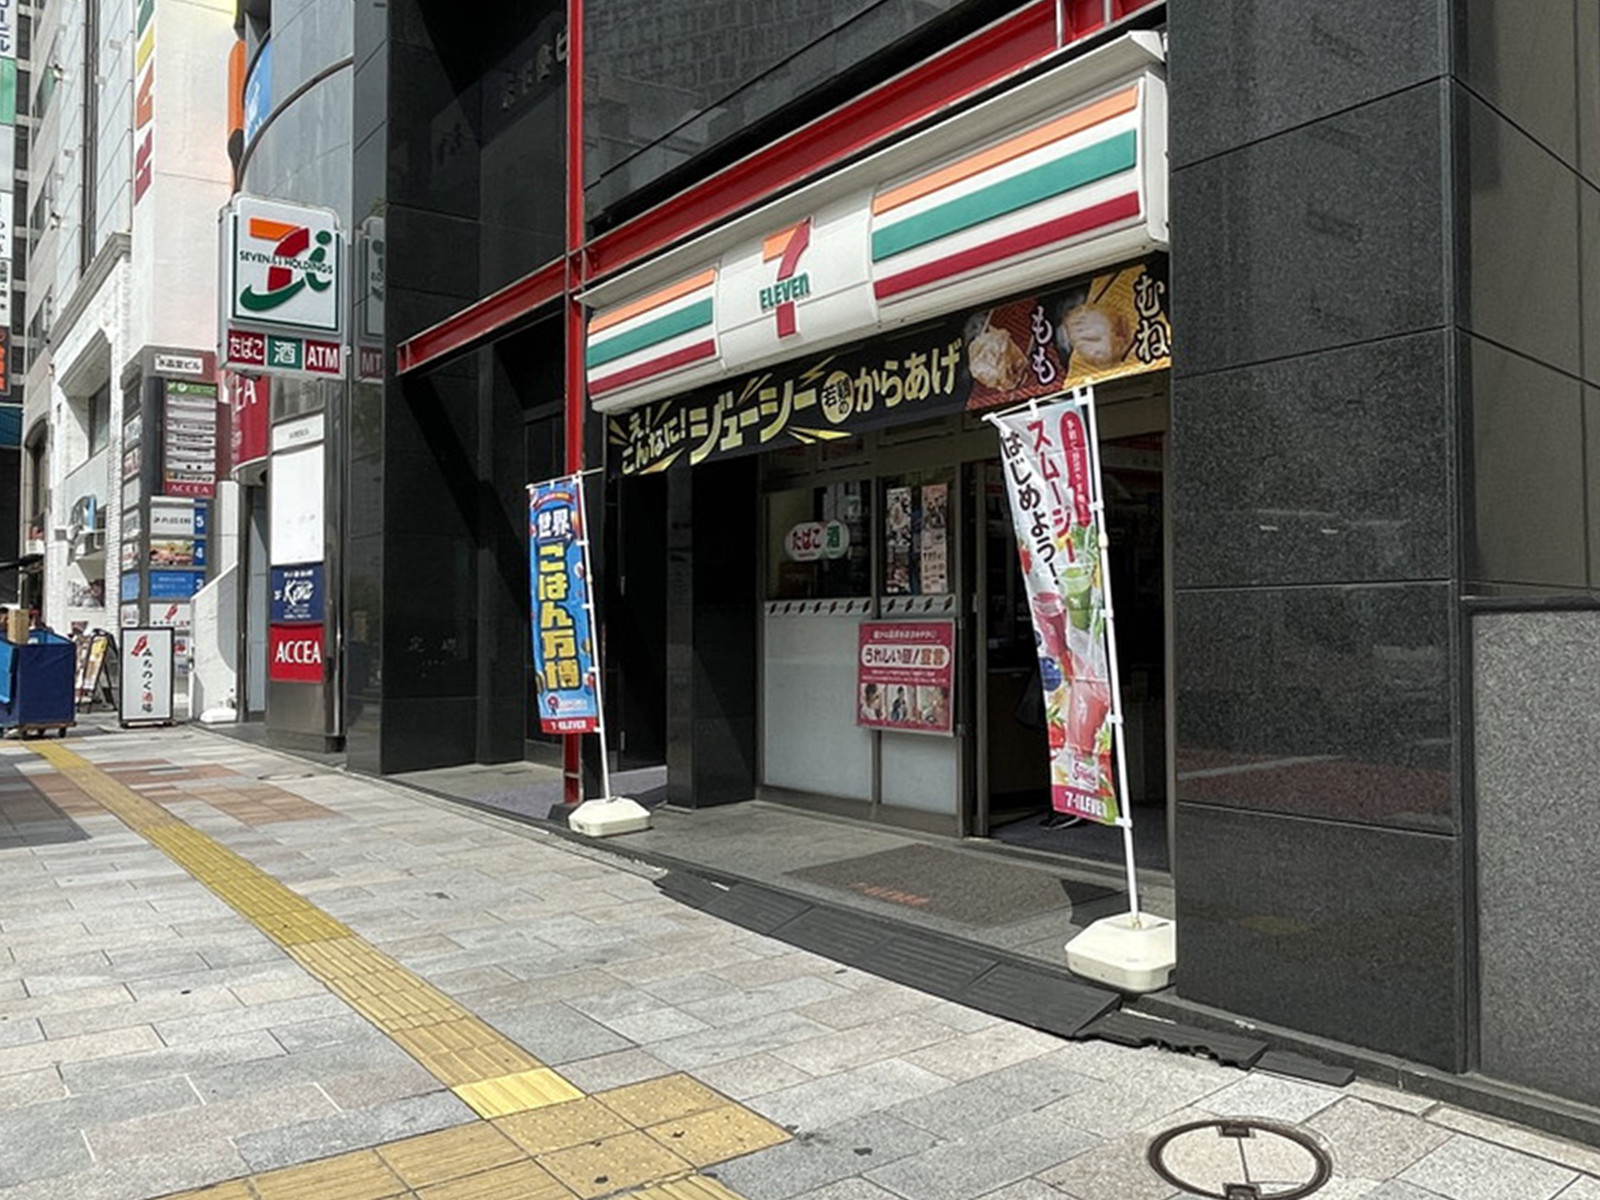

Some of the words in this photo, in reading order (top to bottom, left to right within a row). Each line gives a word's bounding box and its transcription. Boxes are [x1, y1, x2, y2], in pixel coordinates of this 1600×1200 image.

[284, 258, 333, 274] HOLDINGS
[1134, 274, 1170, 363] むね
[229, 337, 264, 360] たばこ
[274, 341, 297, 364] 酒
[1031, 305, 1057, 386] もも
[307, 346, 338, 369] ATM
[689, 380, 817, 465] ジューシー
[854, 338, 962, 413] からあげ
[621, 408, 687, 475] こんなに!
[170, 483, 210, 494] ACCEA
[1027, 419, 1075, 564] スムージー
[196, 516, 204, 528] 5
[537, 508, 570, 538] 世界
[792, 527, 822, 551] たばこ
[195, 547, 204, 559] 4
[539, 542, 580, 689] ごはん万博
[275, 641, 321, 664] ACCEA
